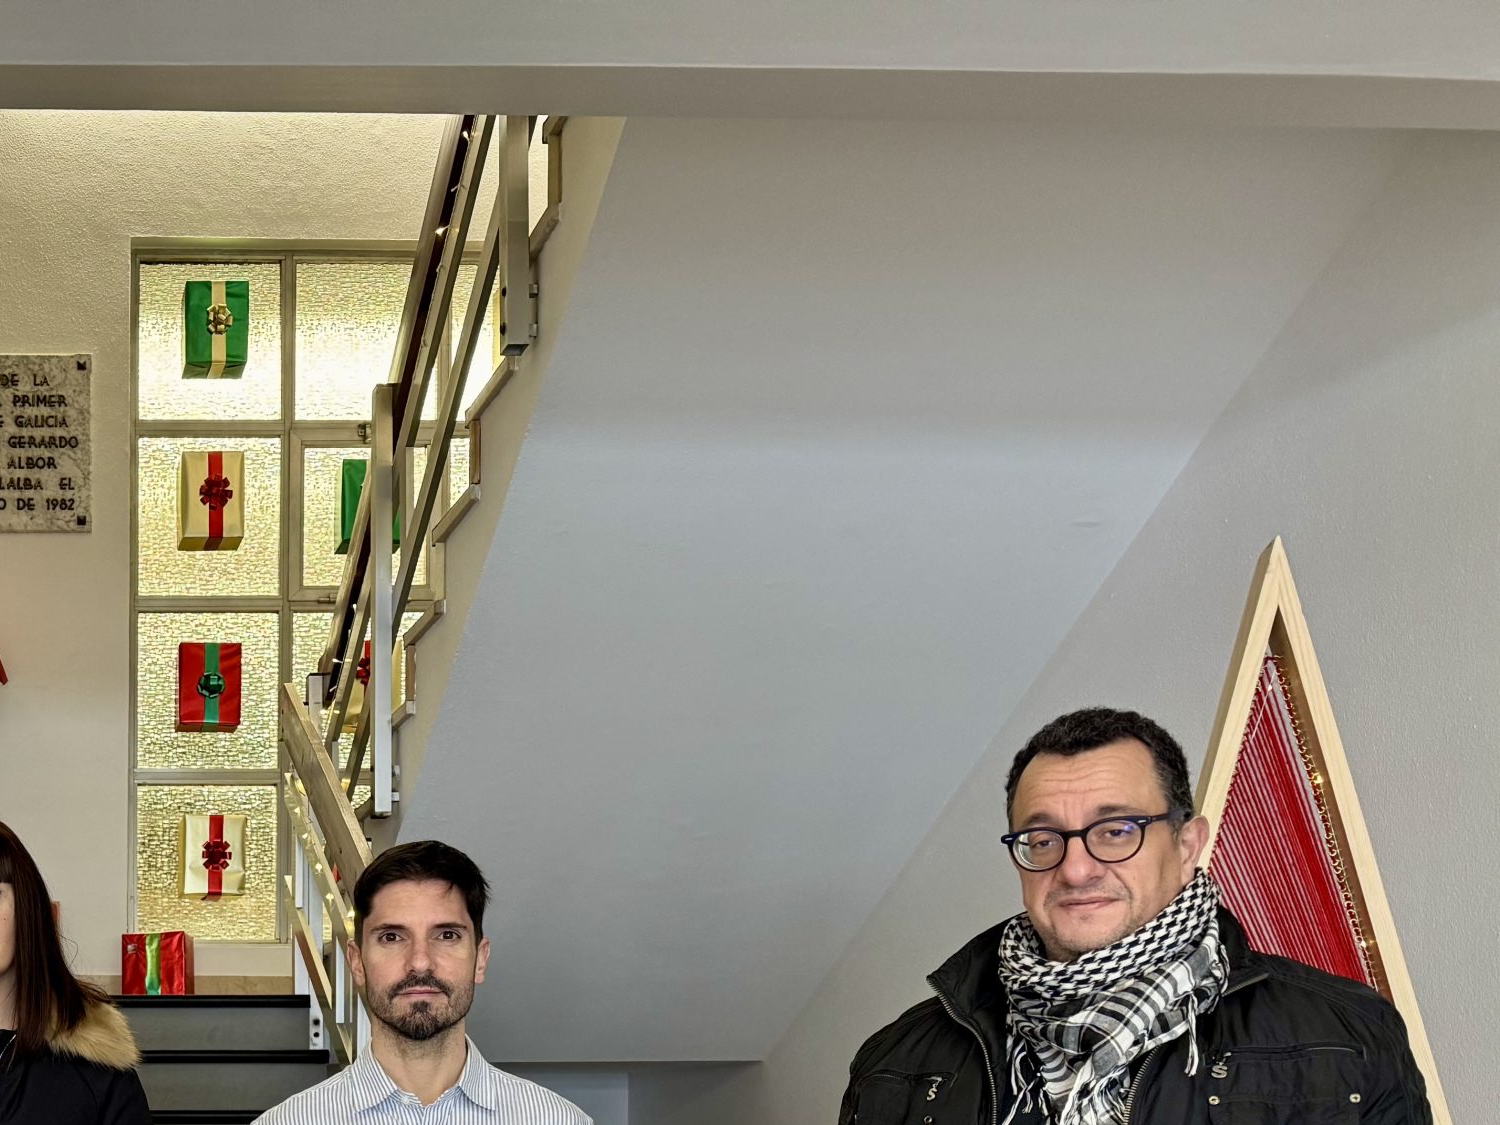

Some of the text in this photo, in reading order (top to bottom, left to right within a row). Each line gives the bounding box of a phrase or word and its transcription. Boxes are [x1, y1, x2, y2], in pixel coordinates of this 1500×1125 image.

[1, 374, 19, 386] DE
[33, 375, 49, 386] LA
[13, 395, 67, 407] PRIMER
[15, 416, 68, 428] GALICIA
[8, 436, 78, 448] GERARDO
[8, 457, 57, 469] ALBOR
[59, 478, 74, 490] EL
[17, 498, 35, 510] DE
[46, 498, 74, 510] 1982
